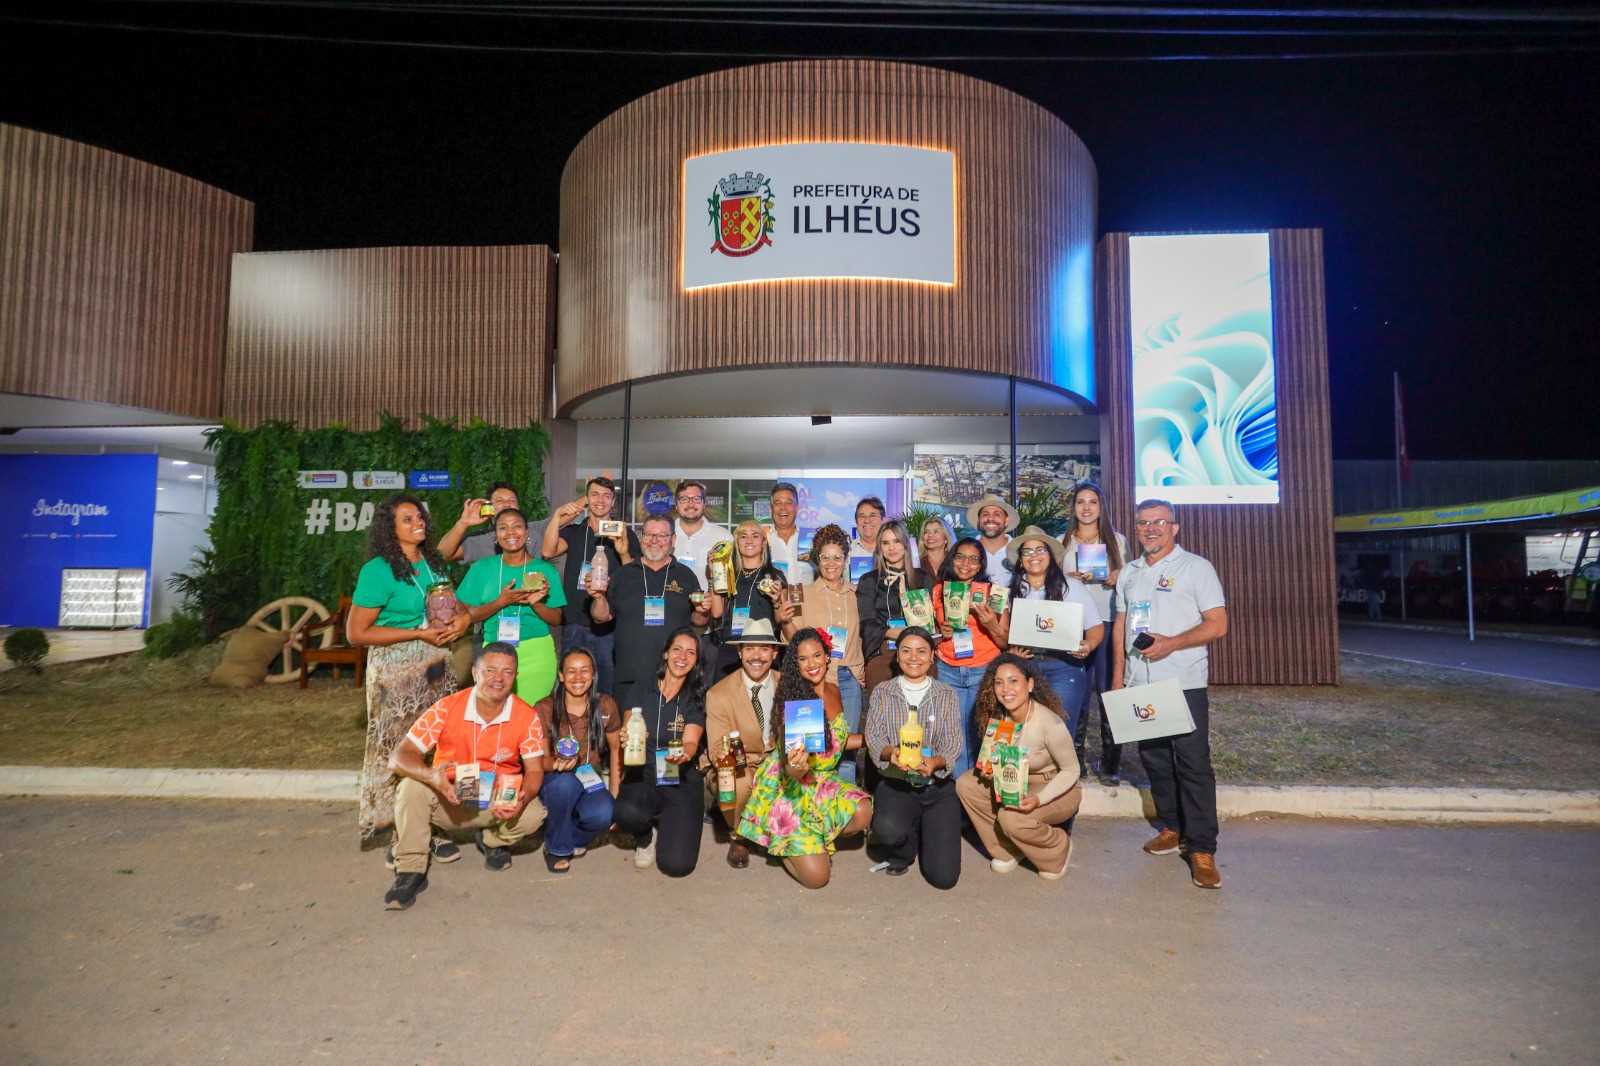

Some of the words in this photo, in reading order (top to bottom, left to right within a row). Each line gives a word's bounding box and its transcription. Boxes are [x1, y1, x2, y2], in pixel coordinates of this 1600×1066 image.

[793, 184, 894, 200] PREFEITURA
[898, 187, 919, 202] DE
[793, 198, 920, 237] ILHÉUS
